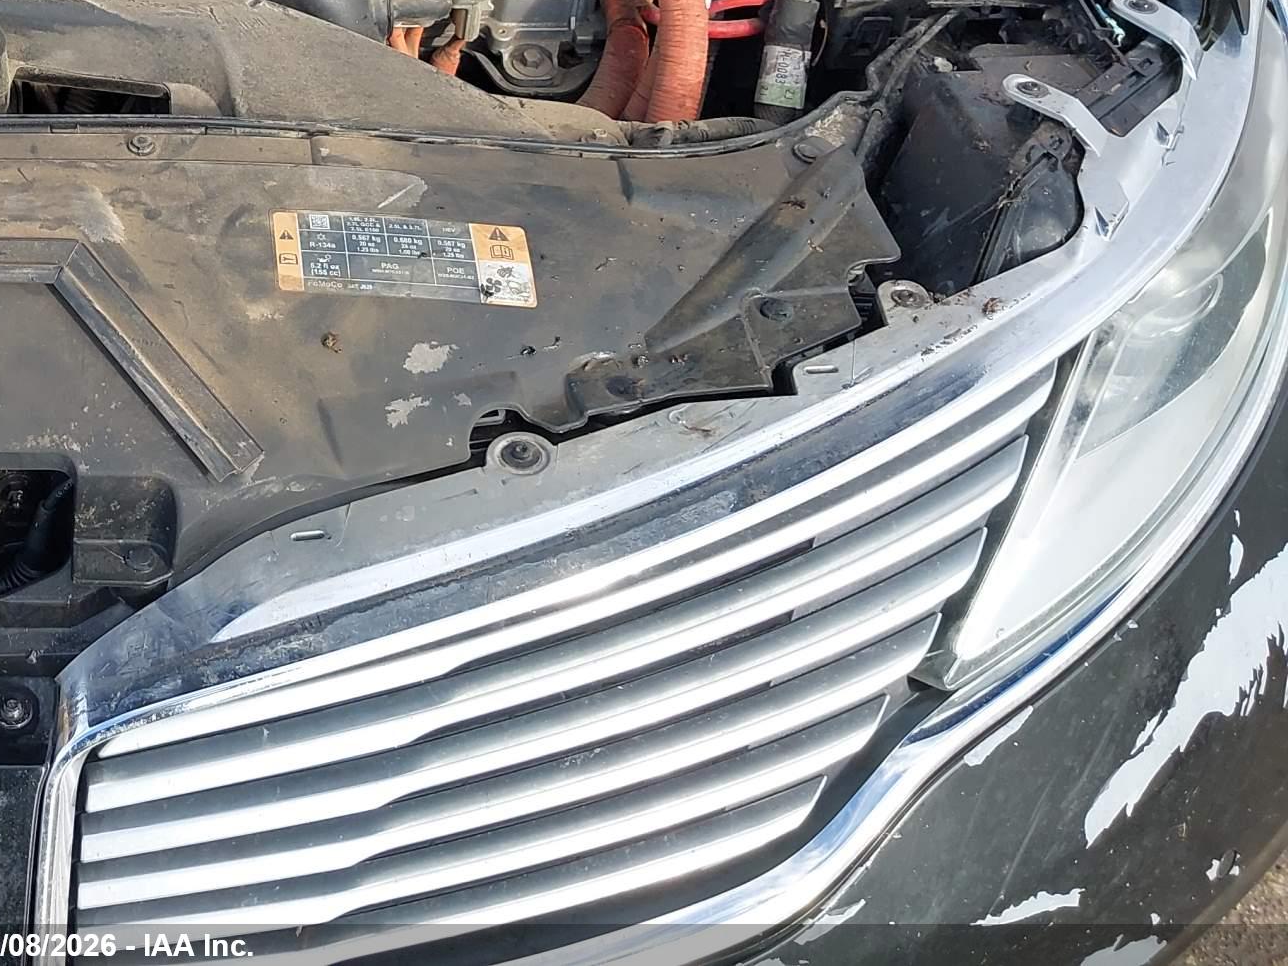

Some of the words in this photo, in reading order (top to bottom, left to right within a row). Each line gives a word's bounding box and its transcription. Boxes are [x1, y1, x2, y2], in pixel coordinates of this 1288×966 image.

[309, 241, 336, 249] R-134a
[380, 262, 400, 270] PAG
[446, 267, 465, 275] POE
